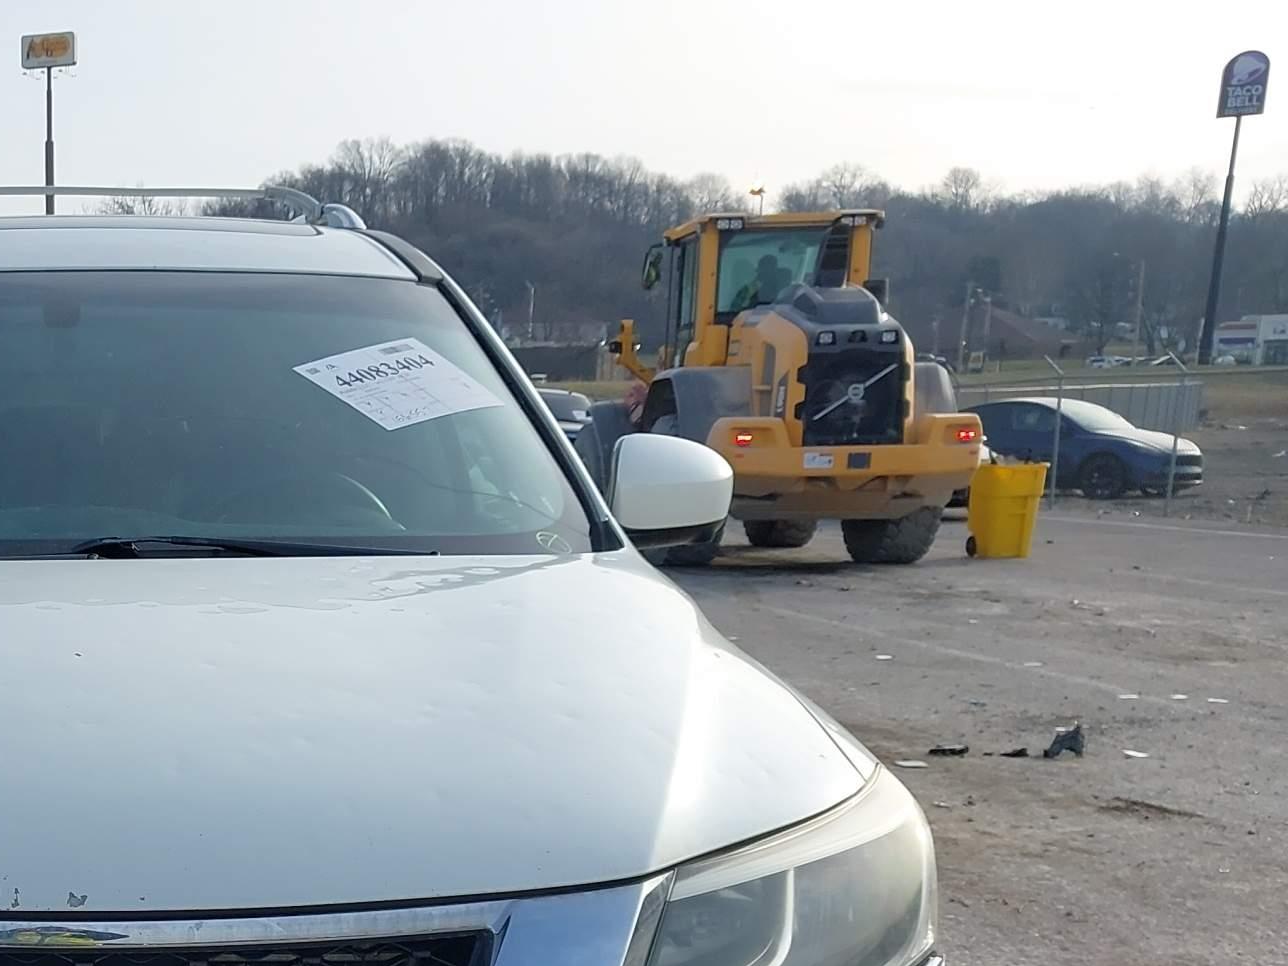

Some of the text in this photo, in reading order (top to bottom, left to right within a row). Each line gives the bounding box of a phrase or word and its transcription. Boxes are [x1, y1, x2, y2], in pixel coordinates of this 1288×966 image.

[1227, 84, 1263, 97] TACO
[1227, 96, 1261, 108] BELL
[335, 354, 436, 388] 44083404
